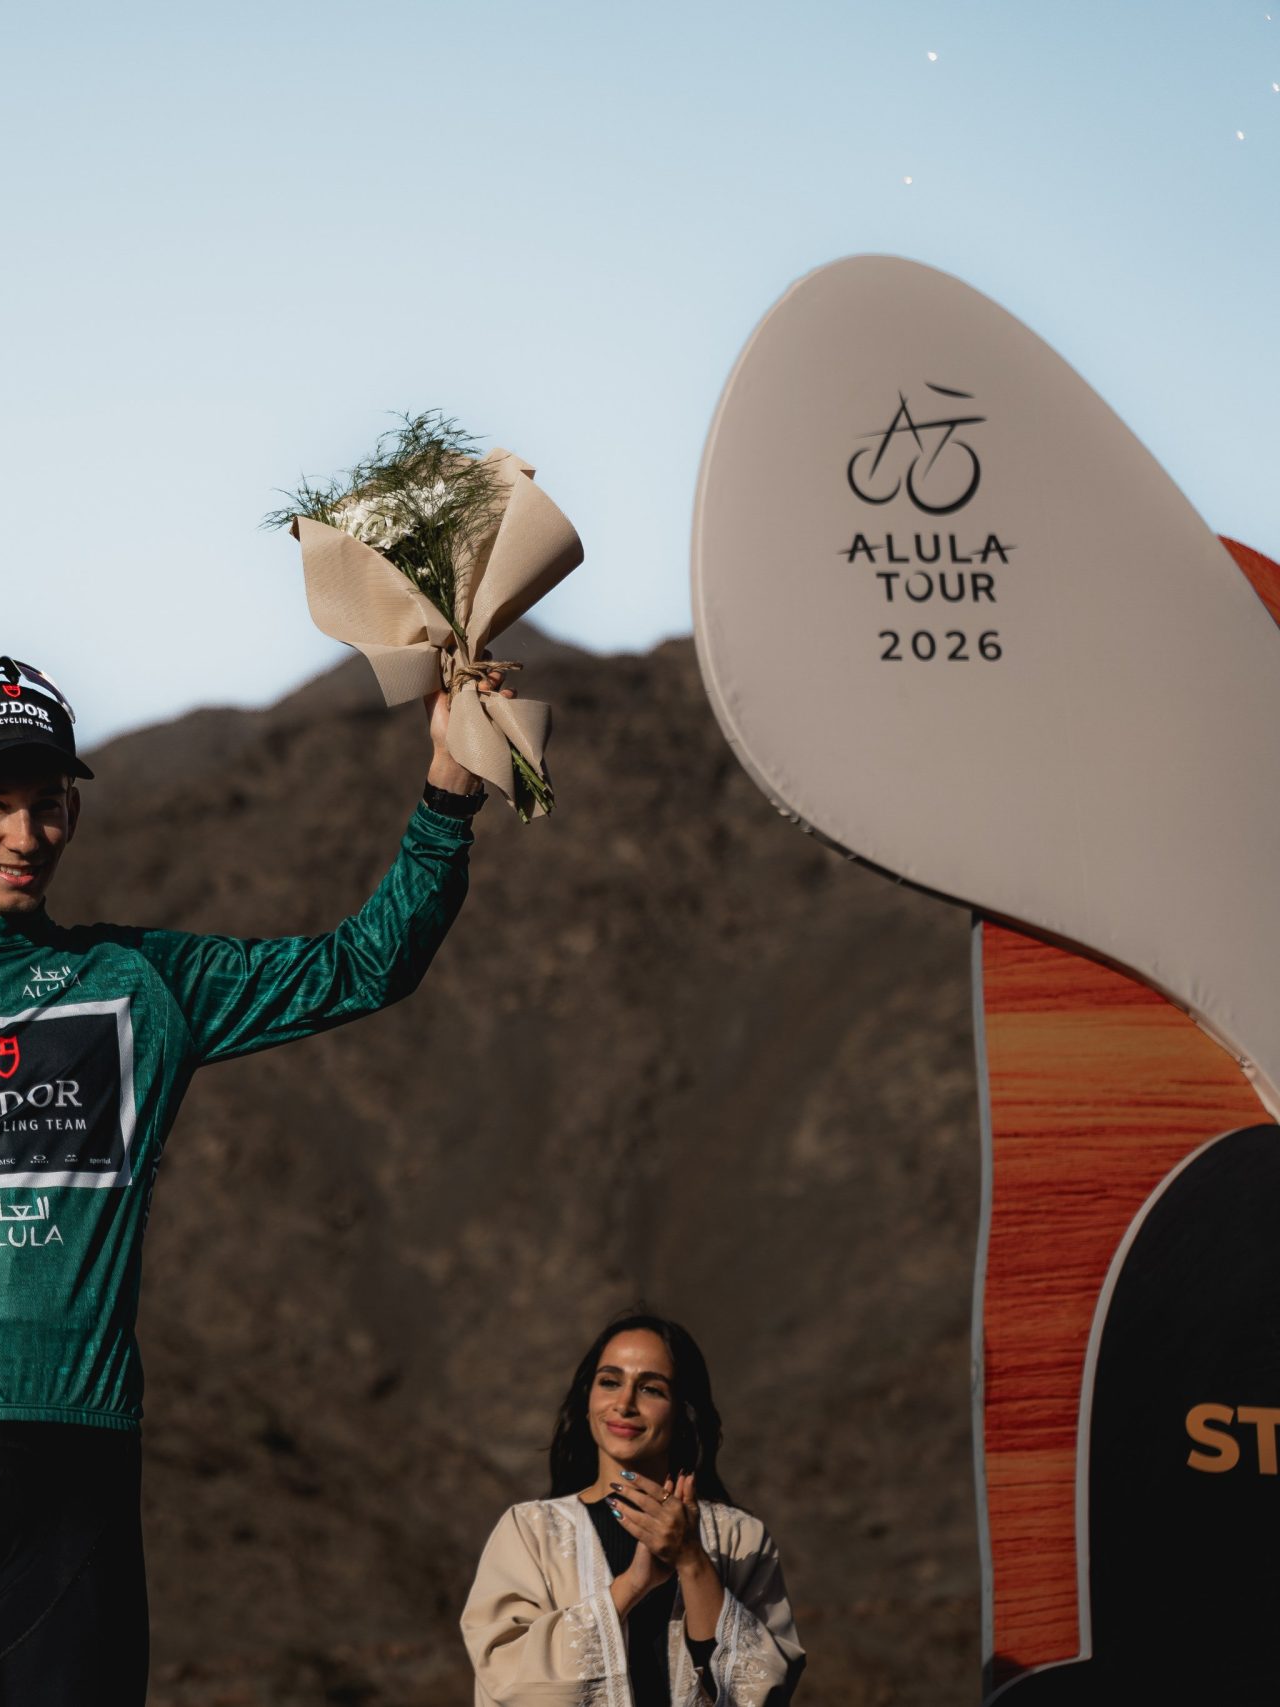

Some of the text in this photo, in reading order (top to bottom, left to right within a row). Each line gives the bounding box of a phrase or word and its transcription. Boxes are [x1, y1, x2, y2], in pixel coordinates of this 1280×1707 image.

[837, 532, 1017, 564] ALULA
[876, 571, 997, 603] TOUR
[878, 629, 1003, 662] 2026
[35, 720, 54, 733] TEAM
[45, 1118, 87, 1131] TEAM
[0, 1157, 16, 1165] MSC
[1185, 1403, 1280, 1475] ST
